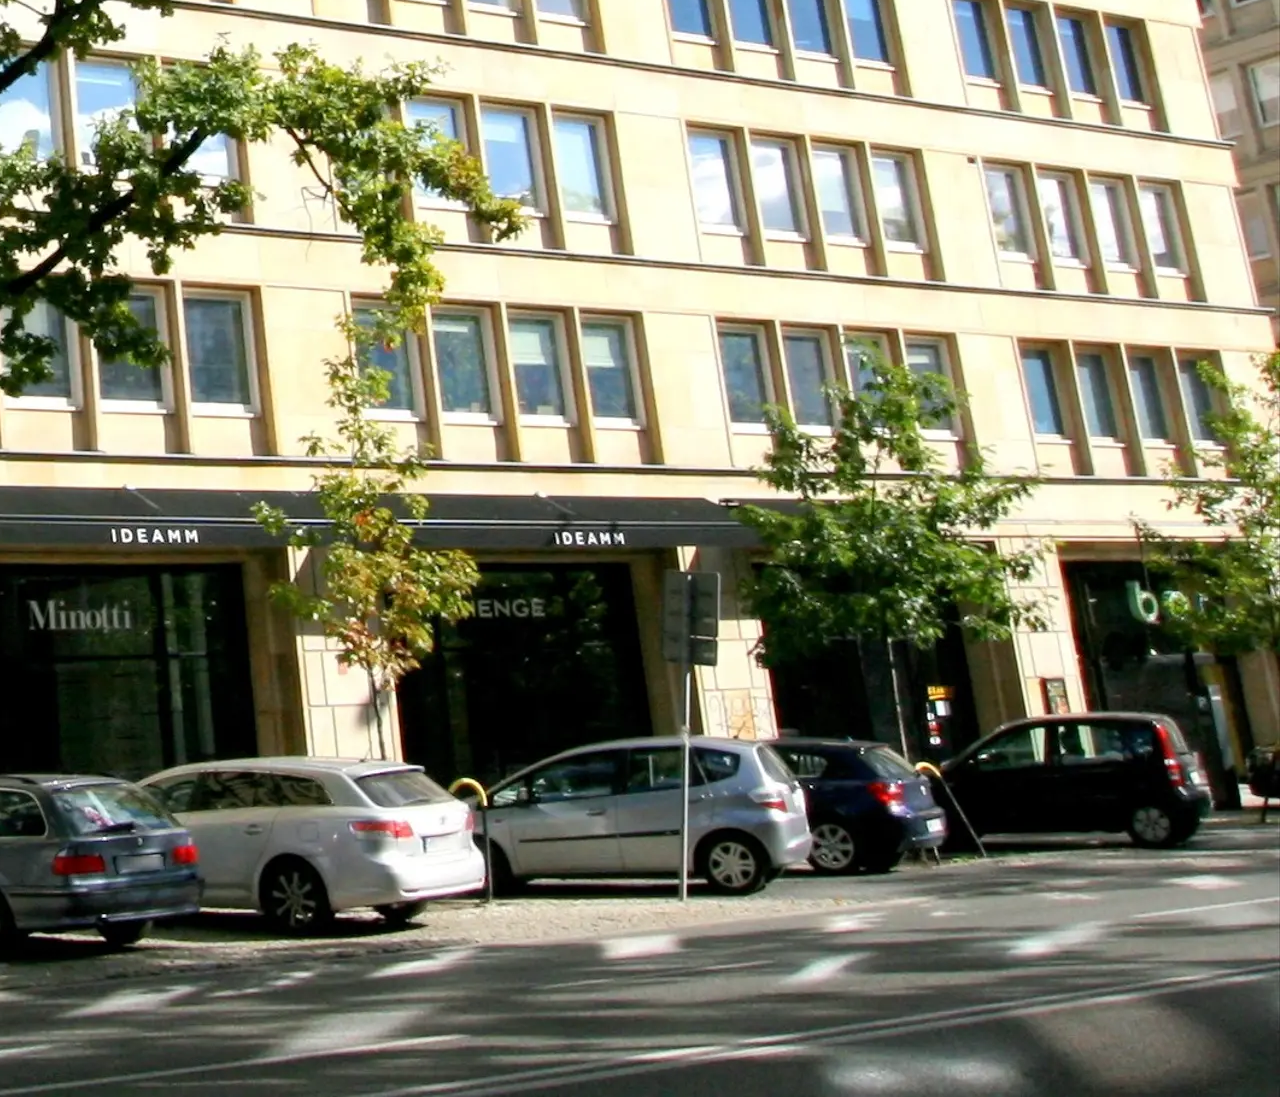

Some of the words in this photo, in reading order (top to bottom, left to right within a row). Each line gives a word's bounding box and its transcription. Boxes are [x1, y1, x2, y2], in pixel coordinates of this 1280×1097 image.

[111, 527, 200, 544] IDEAMM
[554, 531, 626, 545] IDEAMM
[27, 600, 133, 634] Minotti
